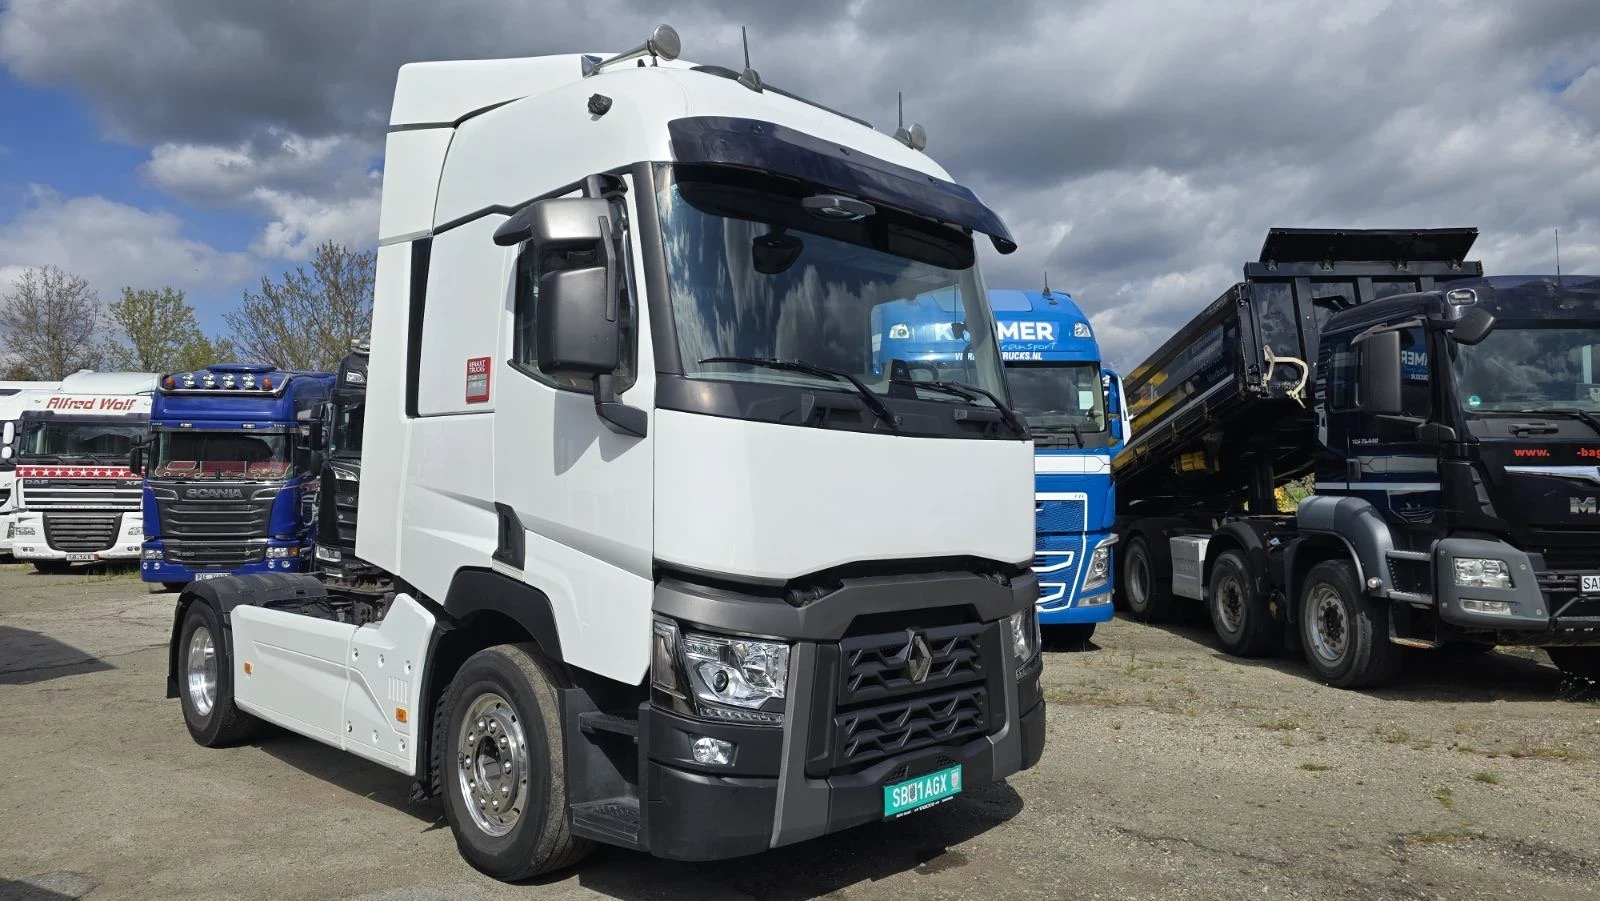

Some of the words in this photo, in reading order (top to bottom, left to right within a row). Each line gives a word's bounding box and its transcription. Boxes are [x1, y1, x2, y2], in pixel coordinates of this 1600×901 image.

[935, 321, 1055, 341] KMER
[1000, 341, 1056, 352] ransport
[46, 398, 96, 409] Alfred
[99, 399, 137, 410] Wolf
[1514, 449, 1550, 457] www.
[185, 488, 242, 498] SCANIA
[893, 788, 908, 808] SB
[917, 774, 947, 800] 1AGX
